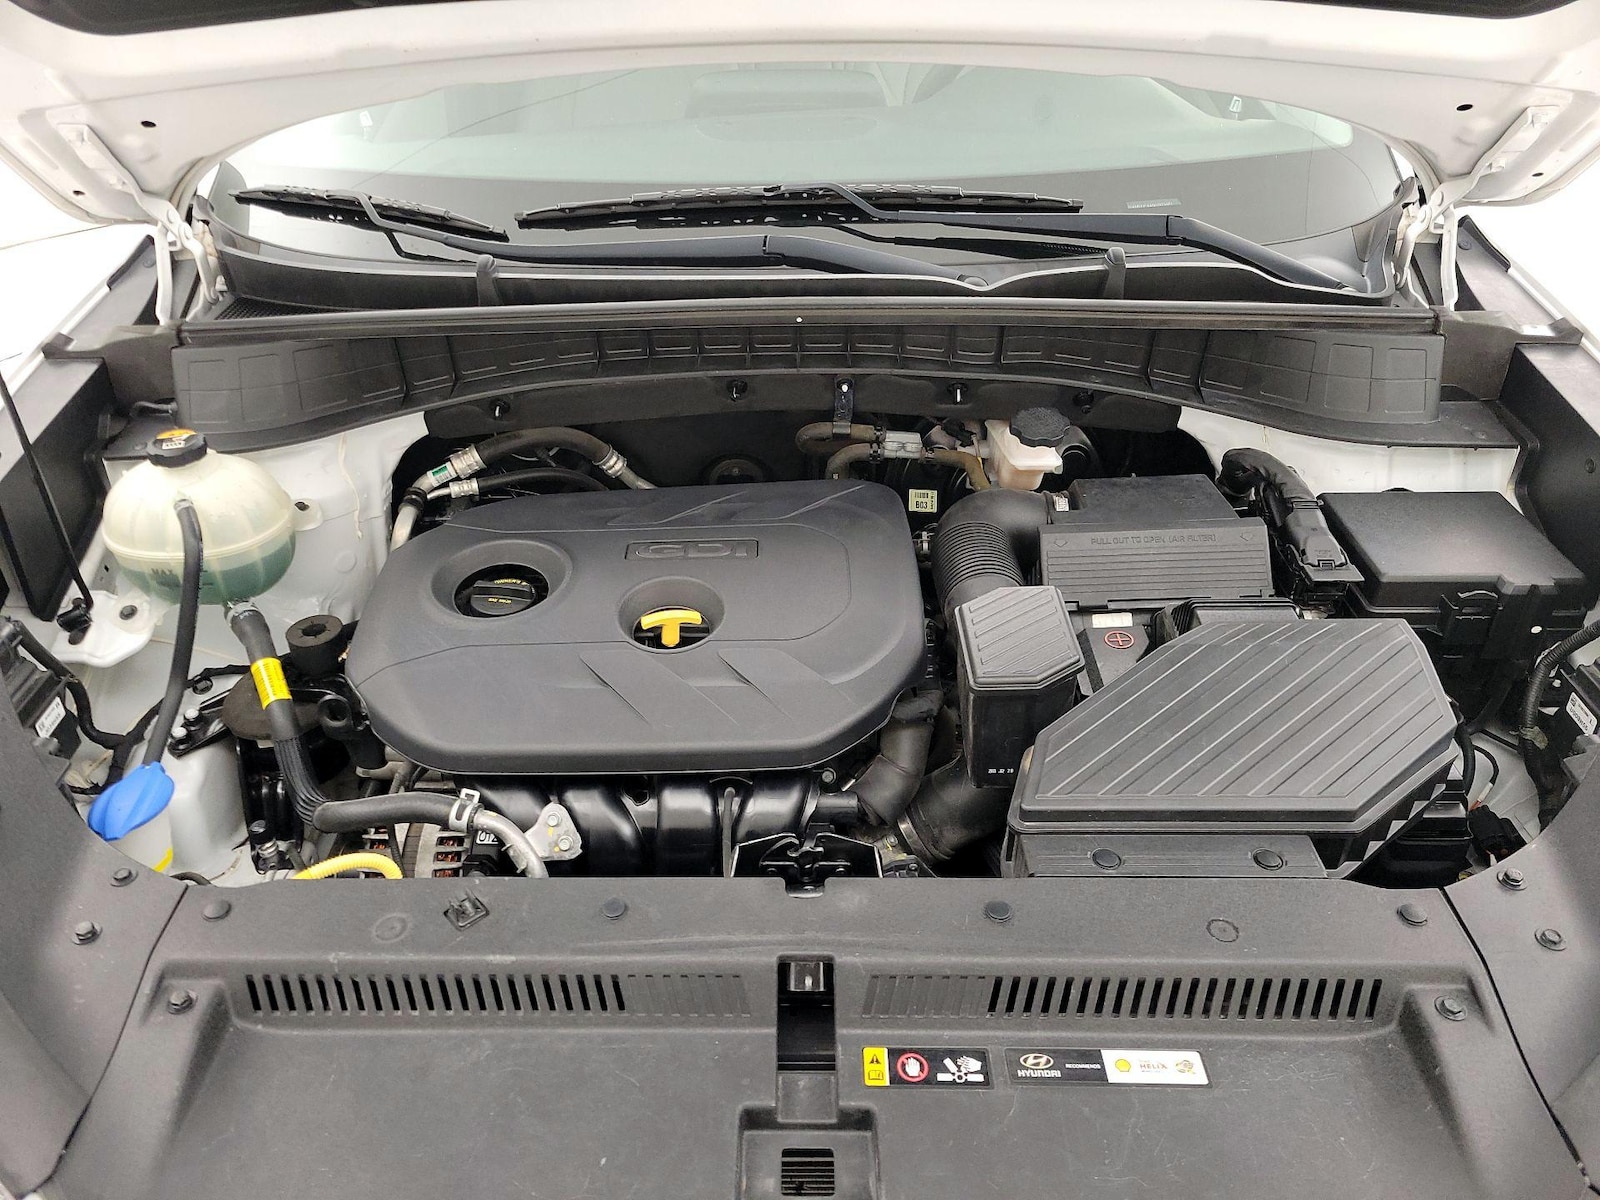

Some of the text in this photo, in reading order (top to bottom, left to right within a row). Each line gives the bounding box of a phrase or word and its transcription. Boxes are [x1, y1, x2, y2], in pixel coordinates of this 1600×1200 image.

[915, 500, 928, 510] B03
[1091, 537, 1111, 545] PULL
[1112, 536, 1129, 545] OUT
[1131, 536, 1141, 544] TO
[1143, 535, 1166, 544] OPEN
[635, 543, 748, 558] GDI
[1139, 1062, 1168, 1070] HELIX
[1017, 1069, 1062, 1078] HYUNDAI
